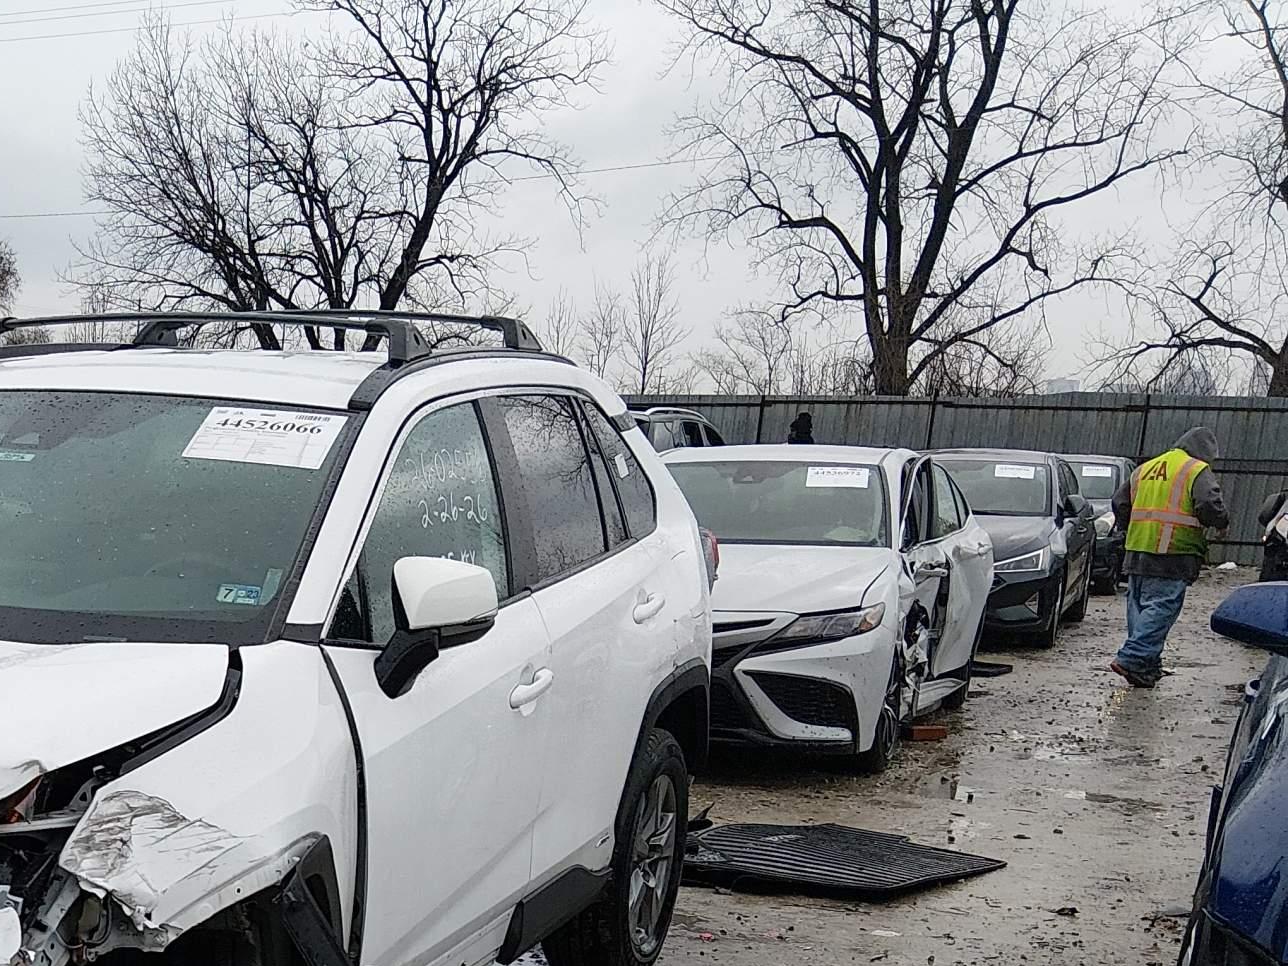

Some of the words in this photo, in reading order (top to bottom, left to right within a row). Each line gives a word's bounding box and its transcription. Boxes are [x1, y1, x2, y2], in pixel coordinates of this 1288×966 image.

[216, 417, 323, 435] 44526066
[418, 493, 488, 528] 2-26-26
[223, 588, 234, 599] 7
